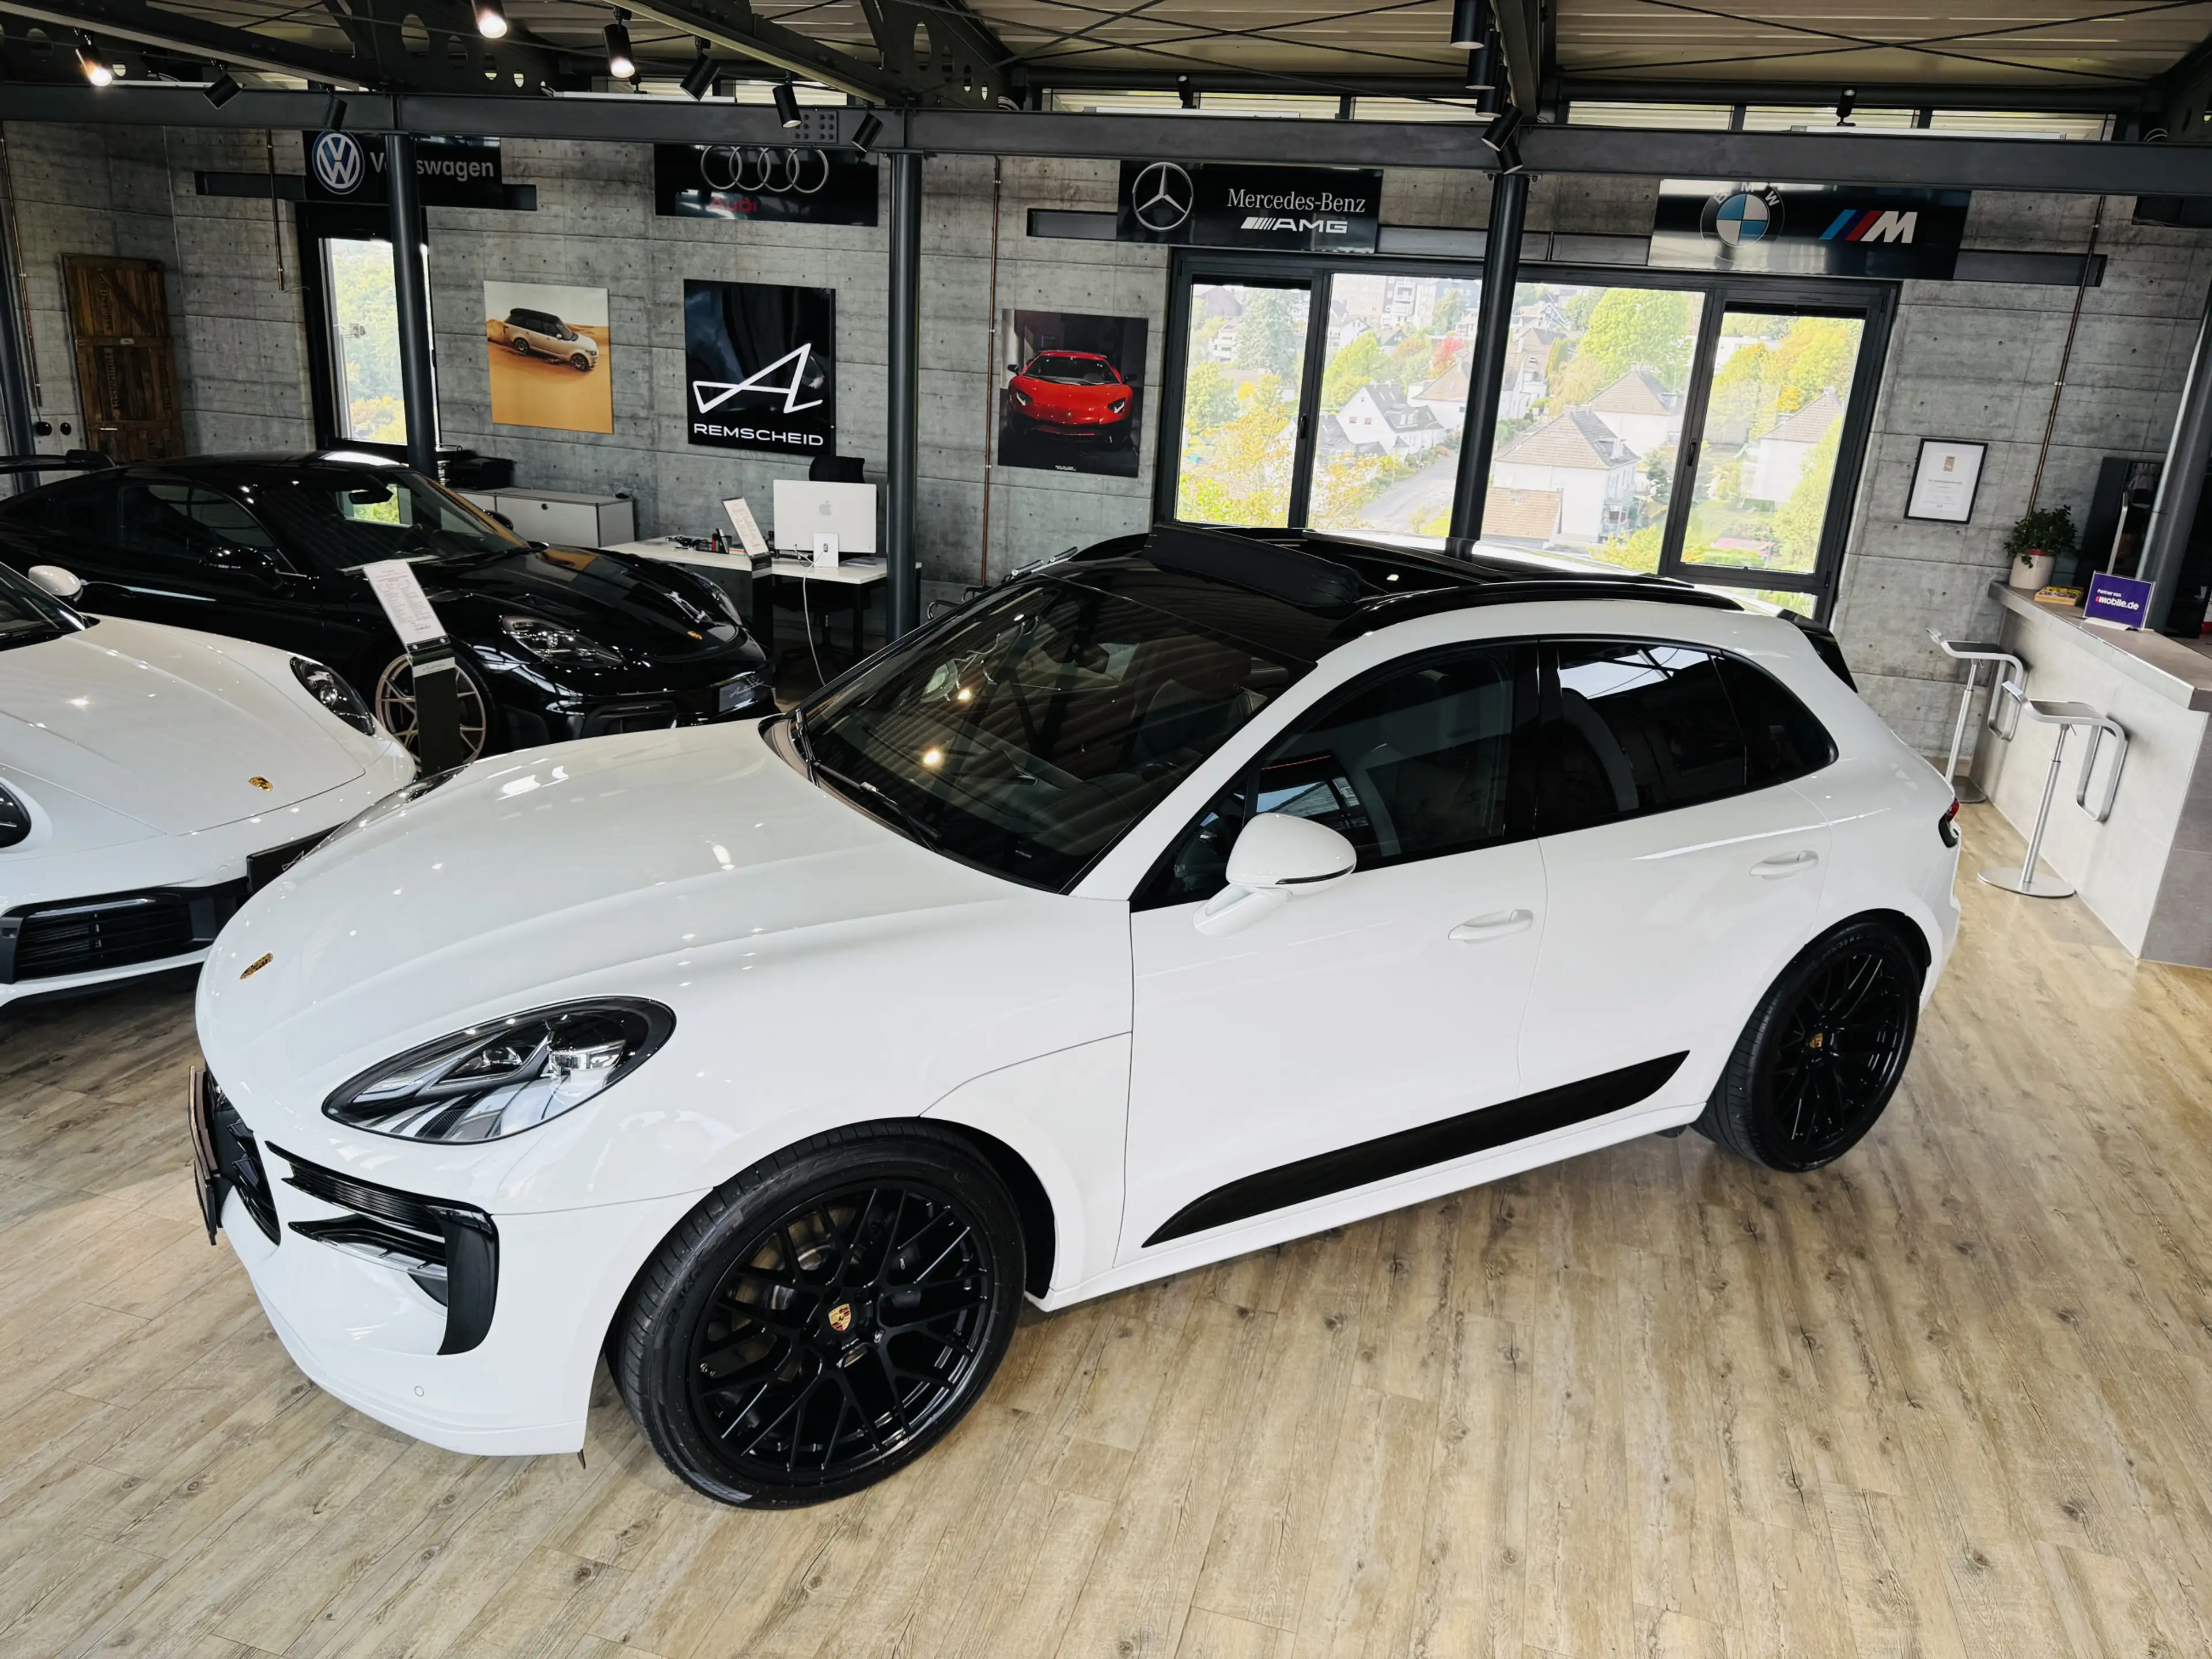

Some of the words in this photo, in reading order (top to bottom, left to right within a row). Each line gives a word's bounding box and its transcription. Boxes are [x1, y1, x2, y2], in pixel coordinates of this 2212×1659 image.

[370, 152, 494, 181] Vswagen
[707, 195, 758, 213] Audi
[1227, 188, 1366, 213] Mercedes-Benz
[1713, 181, 1780, 207] BMW
[1272, 218, 1348, 233] AMG
[694, 423, 824, 446] REMSCHEID
[2099, 596, 2139, 610] mobile.de
